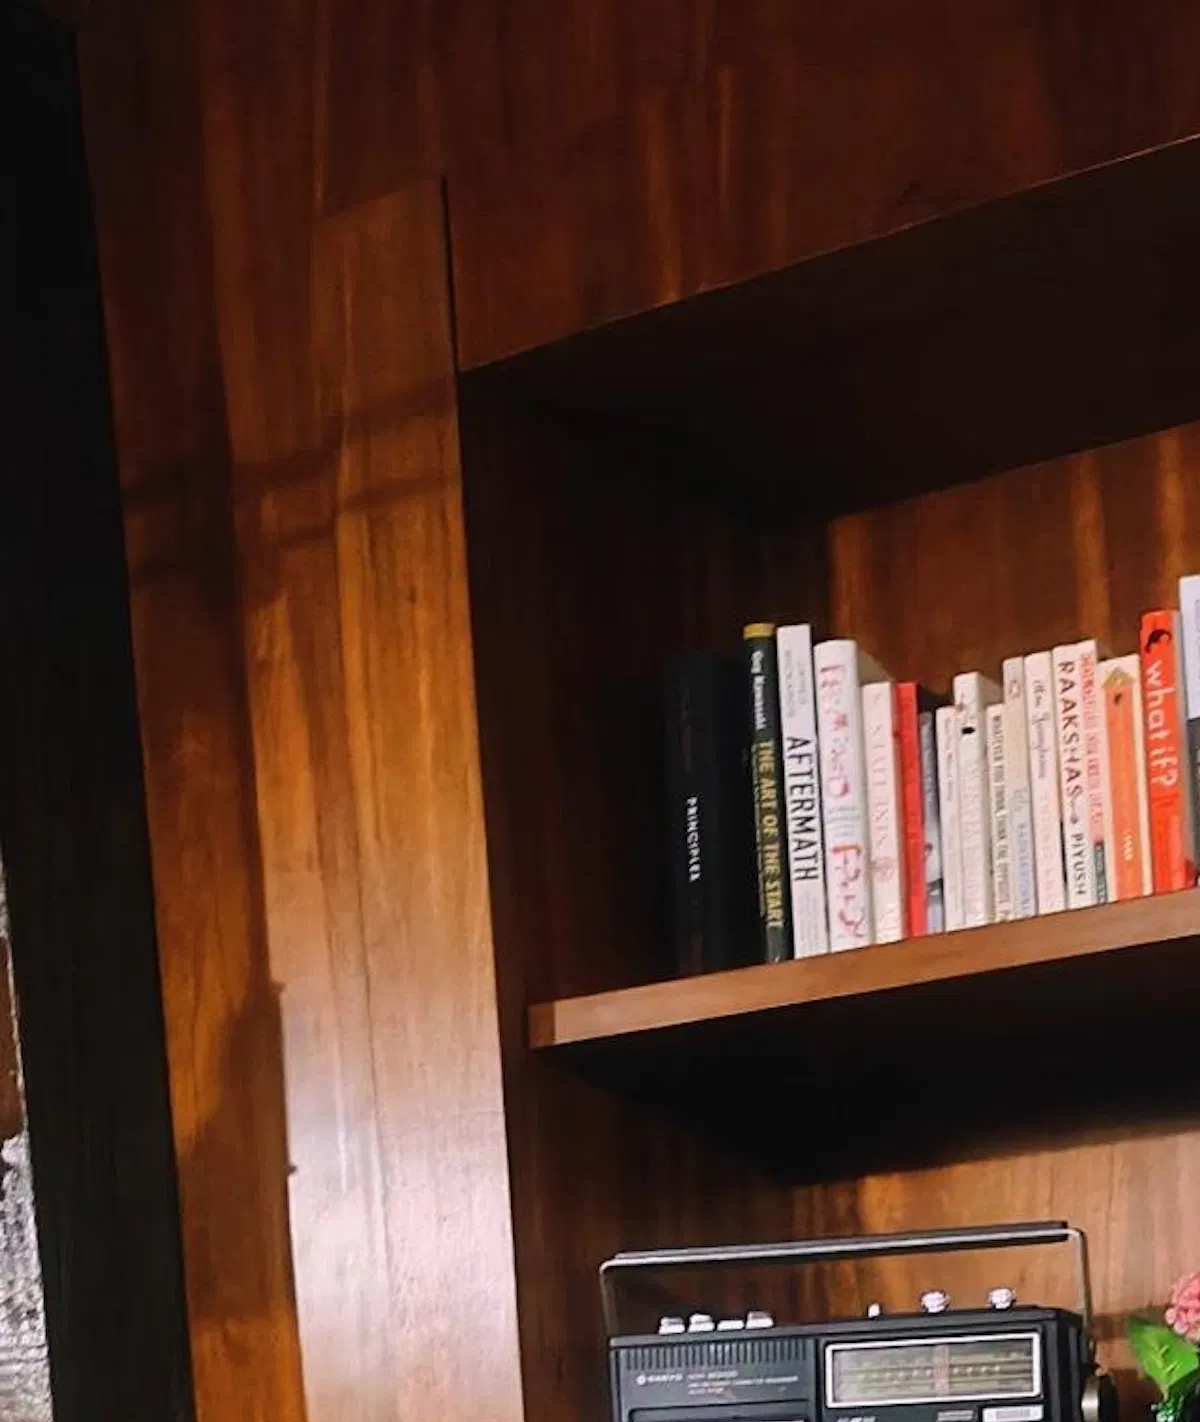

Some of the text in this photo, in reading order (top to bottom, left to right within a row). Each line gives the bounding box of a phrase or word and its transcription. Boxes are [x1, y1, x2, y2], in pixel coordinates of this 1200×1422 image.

[1058, 661, 1083, 799] RAAKSHAS
[1145, 661, 1177, 787] what if?
[686, 797, 701, 882] PRINCIPLES
[758, 740, 783, 930] THE ART OF THE START
[787, 736, 819, 882] AFTERMATH
